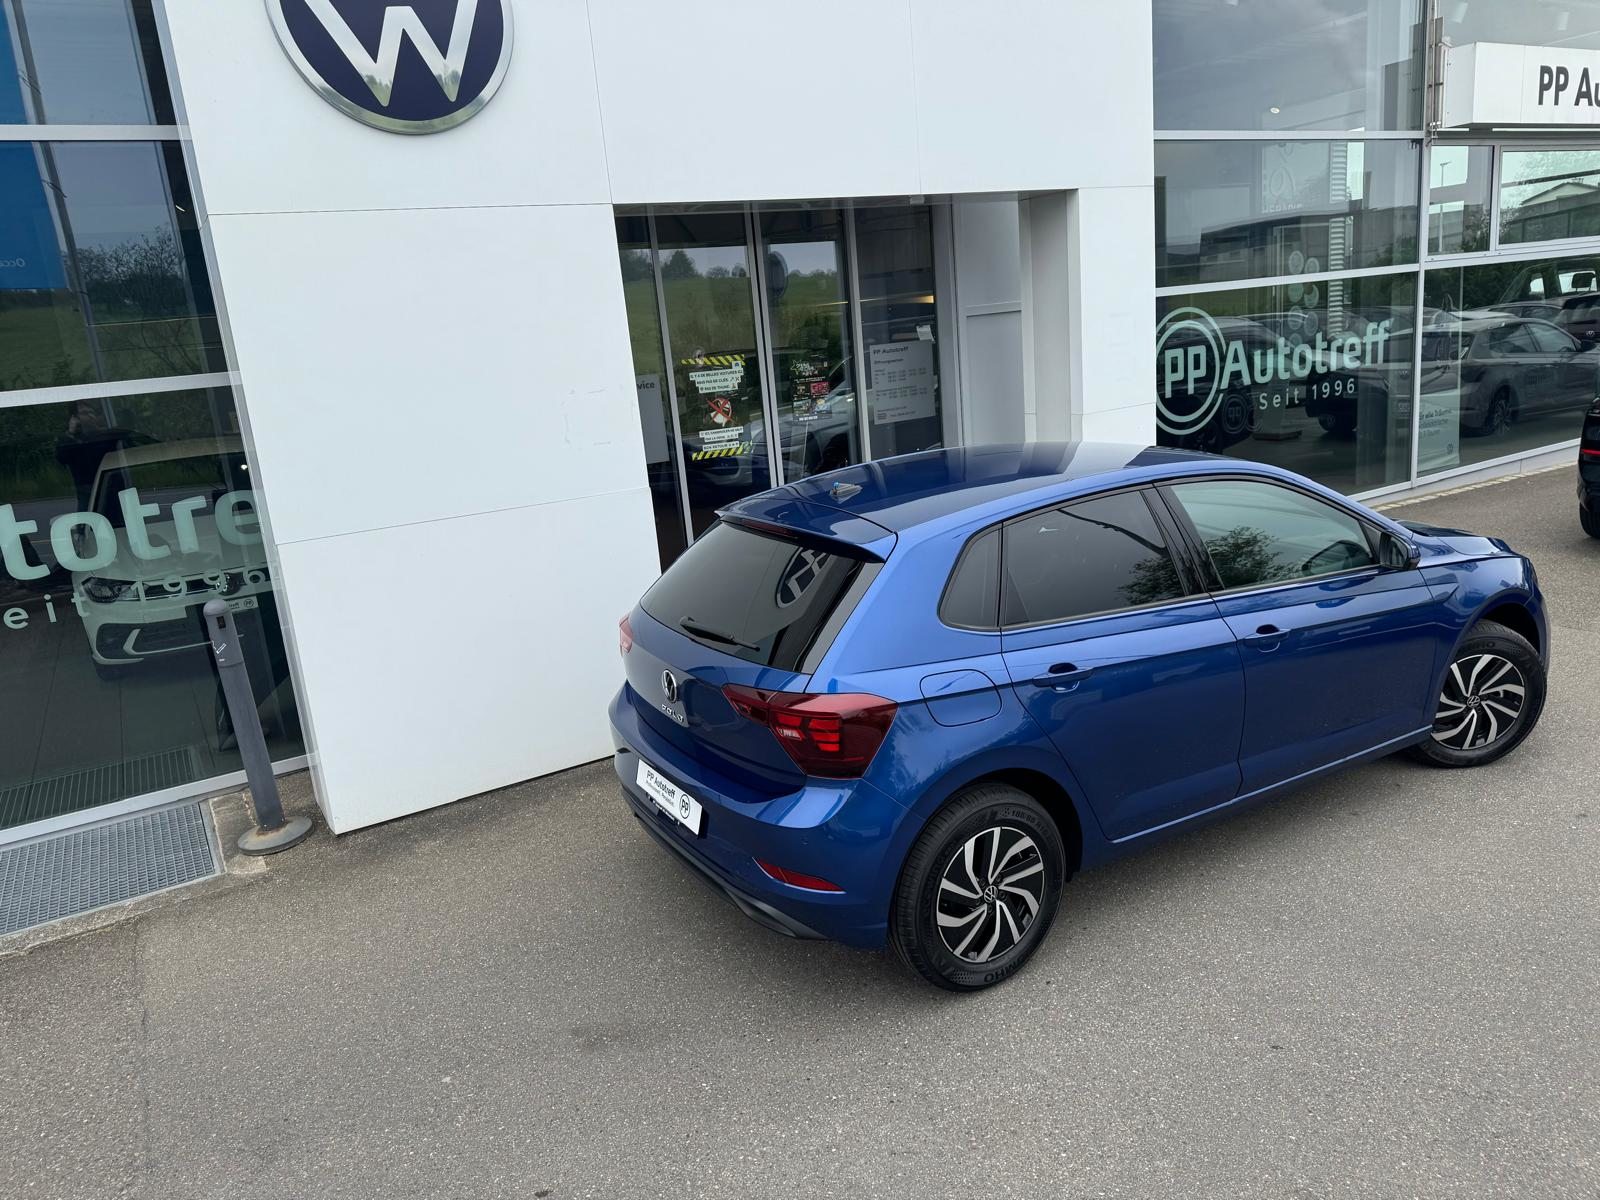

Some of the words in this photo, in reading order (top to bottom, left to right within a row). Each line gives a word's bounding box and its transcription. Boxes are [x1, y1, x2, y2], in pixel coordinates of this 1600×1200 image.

[1538, 65, 1569, 106] PP
[1165, 345, 1207, 399] PP
[1220, 318, 1394, 389] Autotreff
[1259, 388, 1300, 410] Seit
[1312, 378, 1355, 400] 1996
